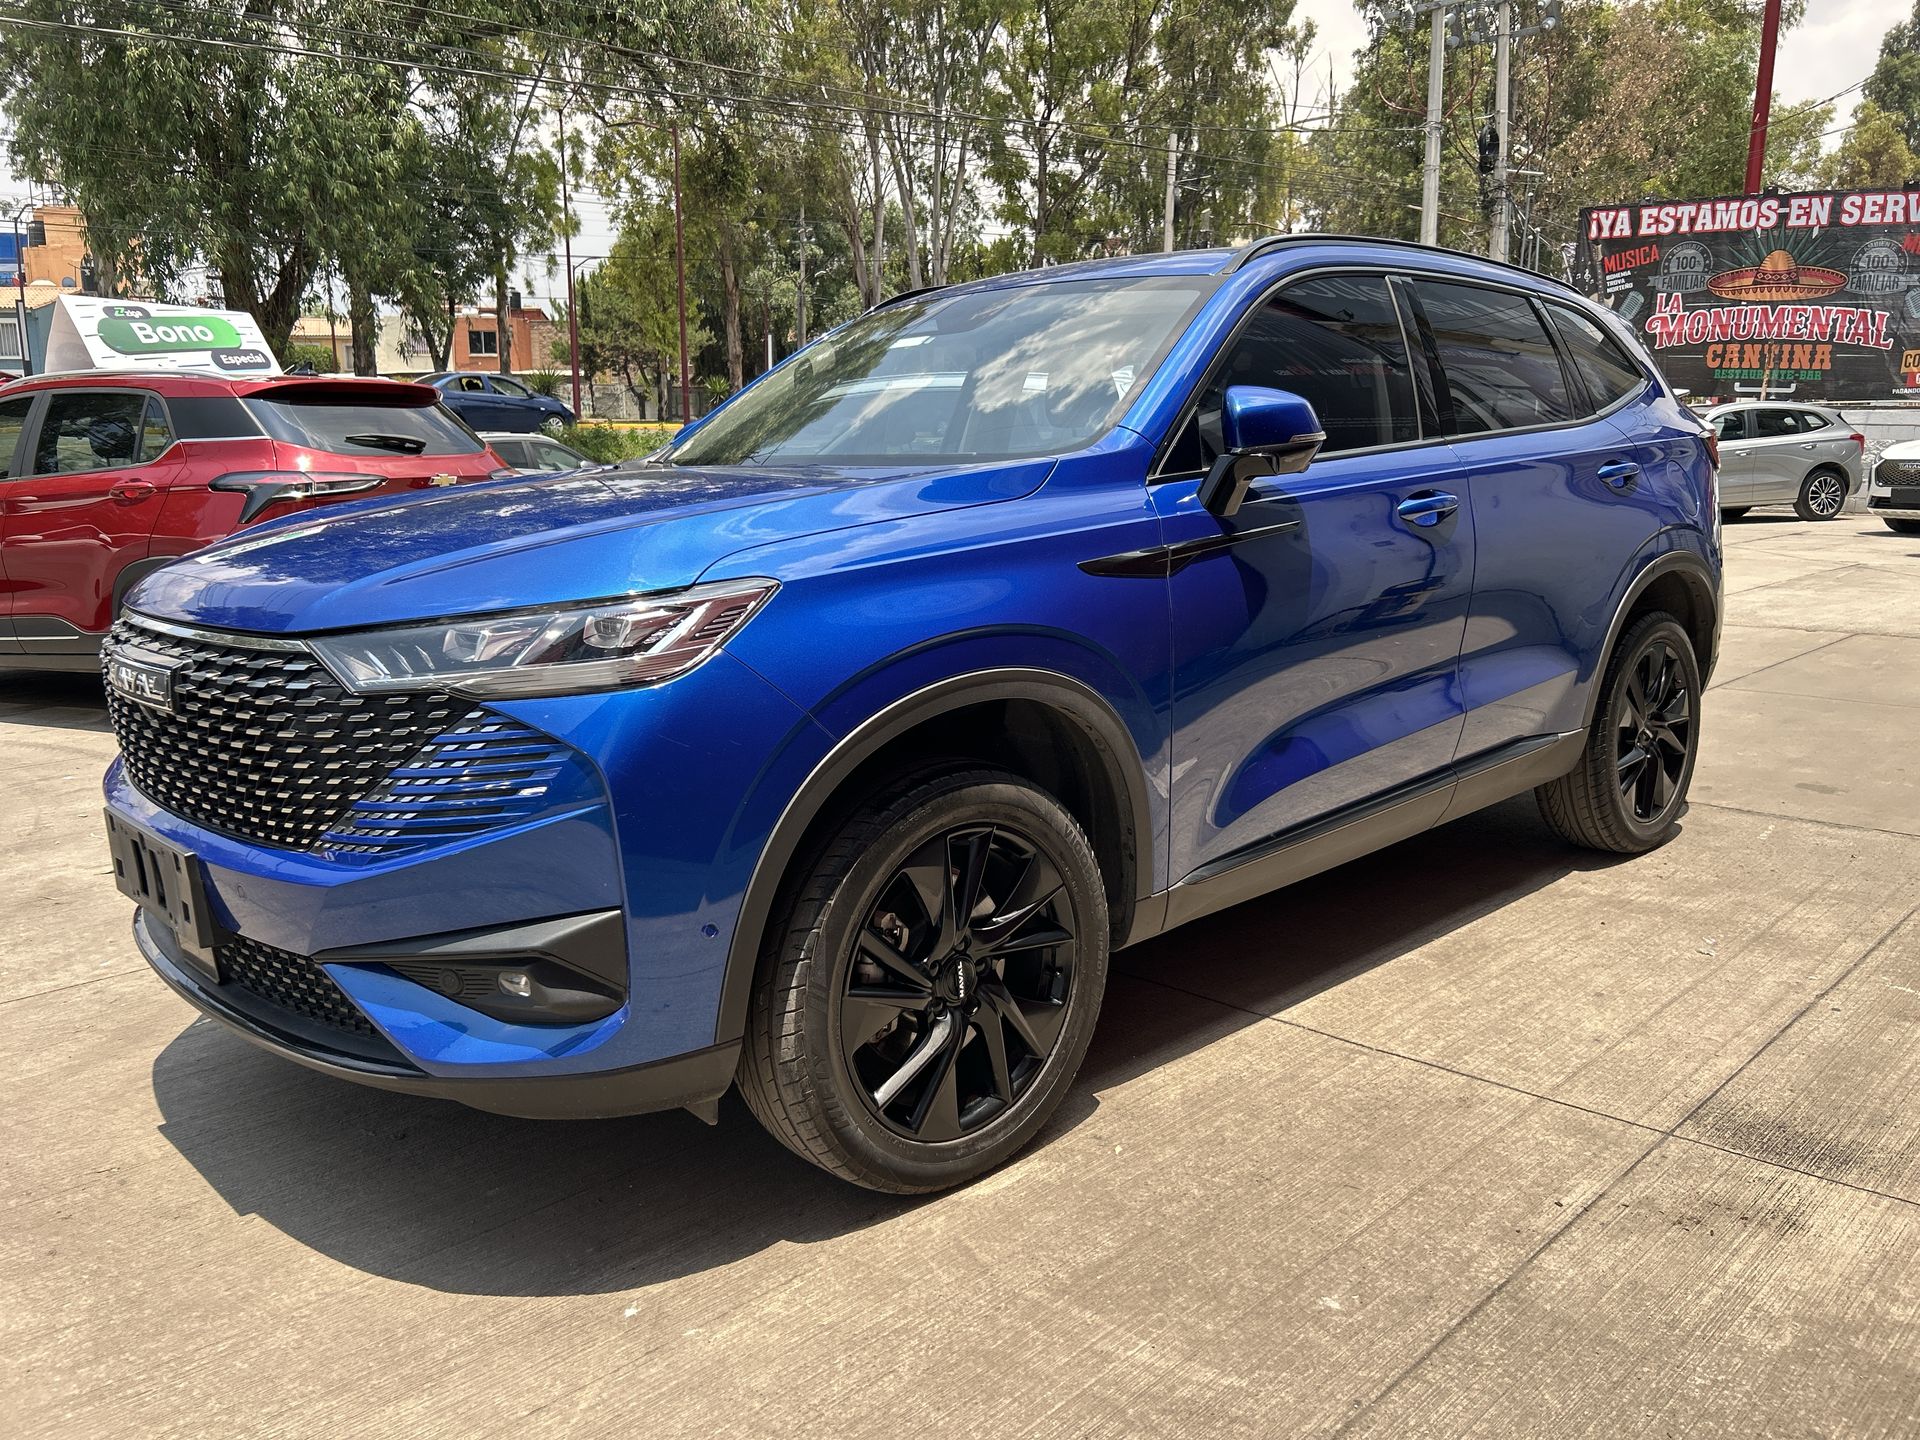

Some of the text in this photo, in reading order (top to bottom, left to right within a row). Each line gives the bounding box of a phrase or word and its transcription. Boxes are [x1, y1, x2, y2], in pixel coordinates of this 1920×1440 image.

[1638, 198, 1779, 236] ESTAMOS
[1787, 197, 1833, 227] EN
[1604, 244, 1659, 273] MUSICA
[1662, 274, 1706, 290] FAMILIAR
[1850, 274, 1900, 291] FAMILIAR
[1655, 292, 1683, 315] LA
[129, 322, 214, 344] Bono
[1645, 305, 1894, 350] MONUMENTAL
[220, 353, 266, 367] Especial
[1706, 344, 1832, 370] CANTINA
[1714, 369, 1822, 381] RESTAURNTE-BAR
